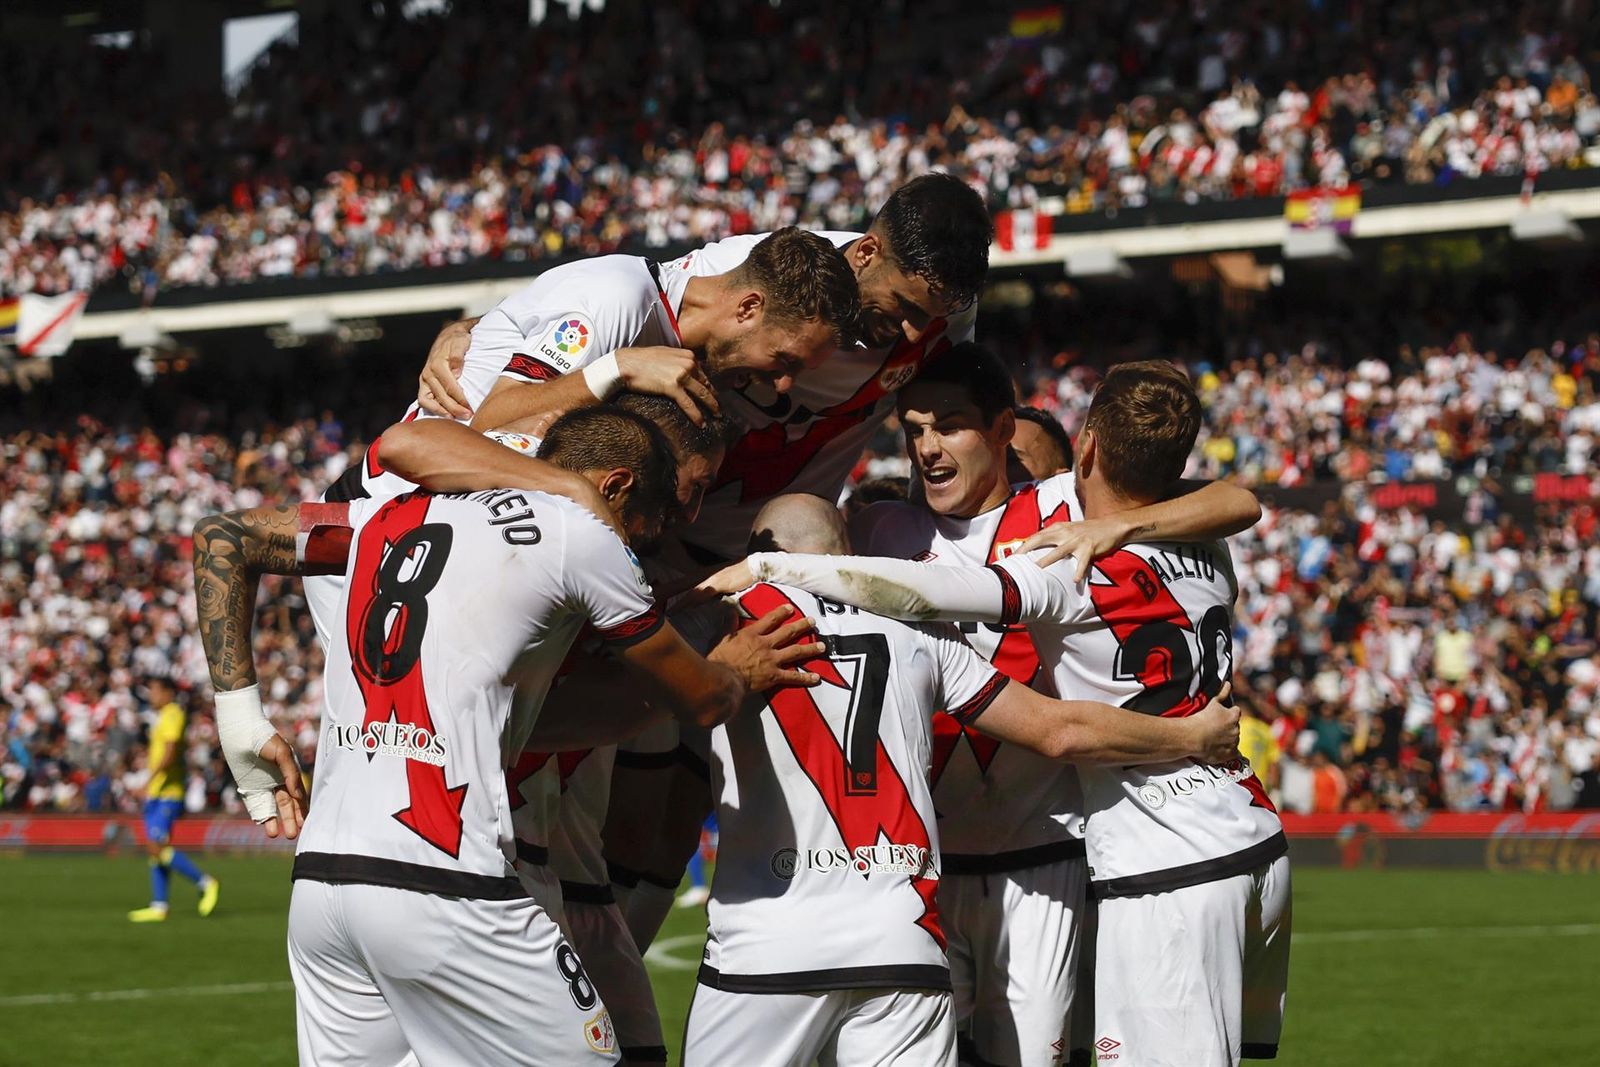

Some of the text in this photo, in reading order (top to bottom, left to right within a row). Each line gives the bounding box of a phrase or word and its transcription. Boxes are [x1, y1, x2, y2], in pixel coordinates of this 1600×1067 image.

[540, 344, 571, 370] LaLiga
[355, 522, 454, 686] 8
[1131, 547, 1216, 604] BALLIU
[815, 632, 891, 797] 7
[807, 848, 849, 874] LOS
[555, 944, 598, 1011] 8
